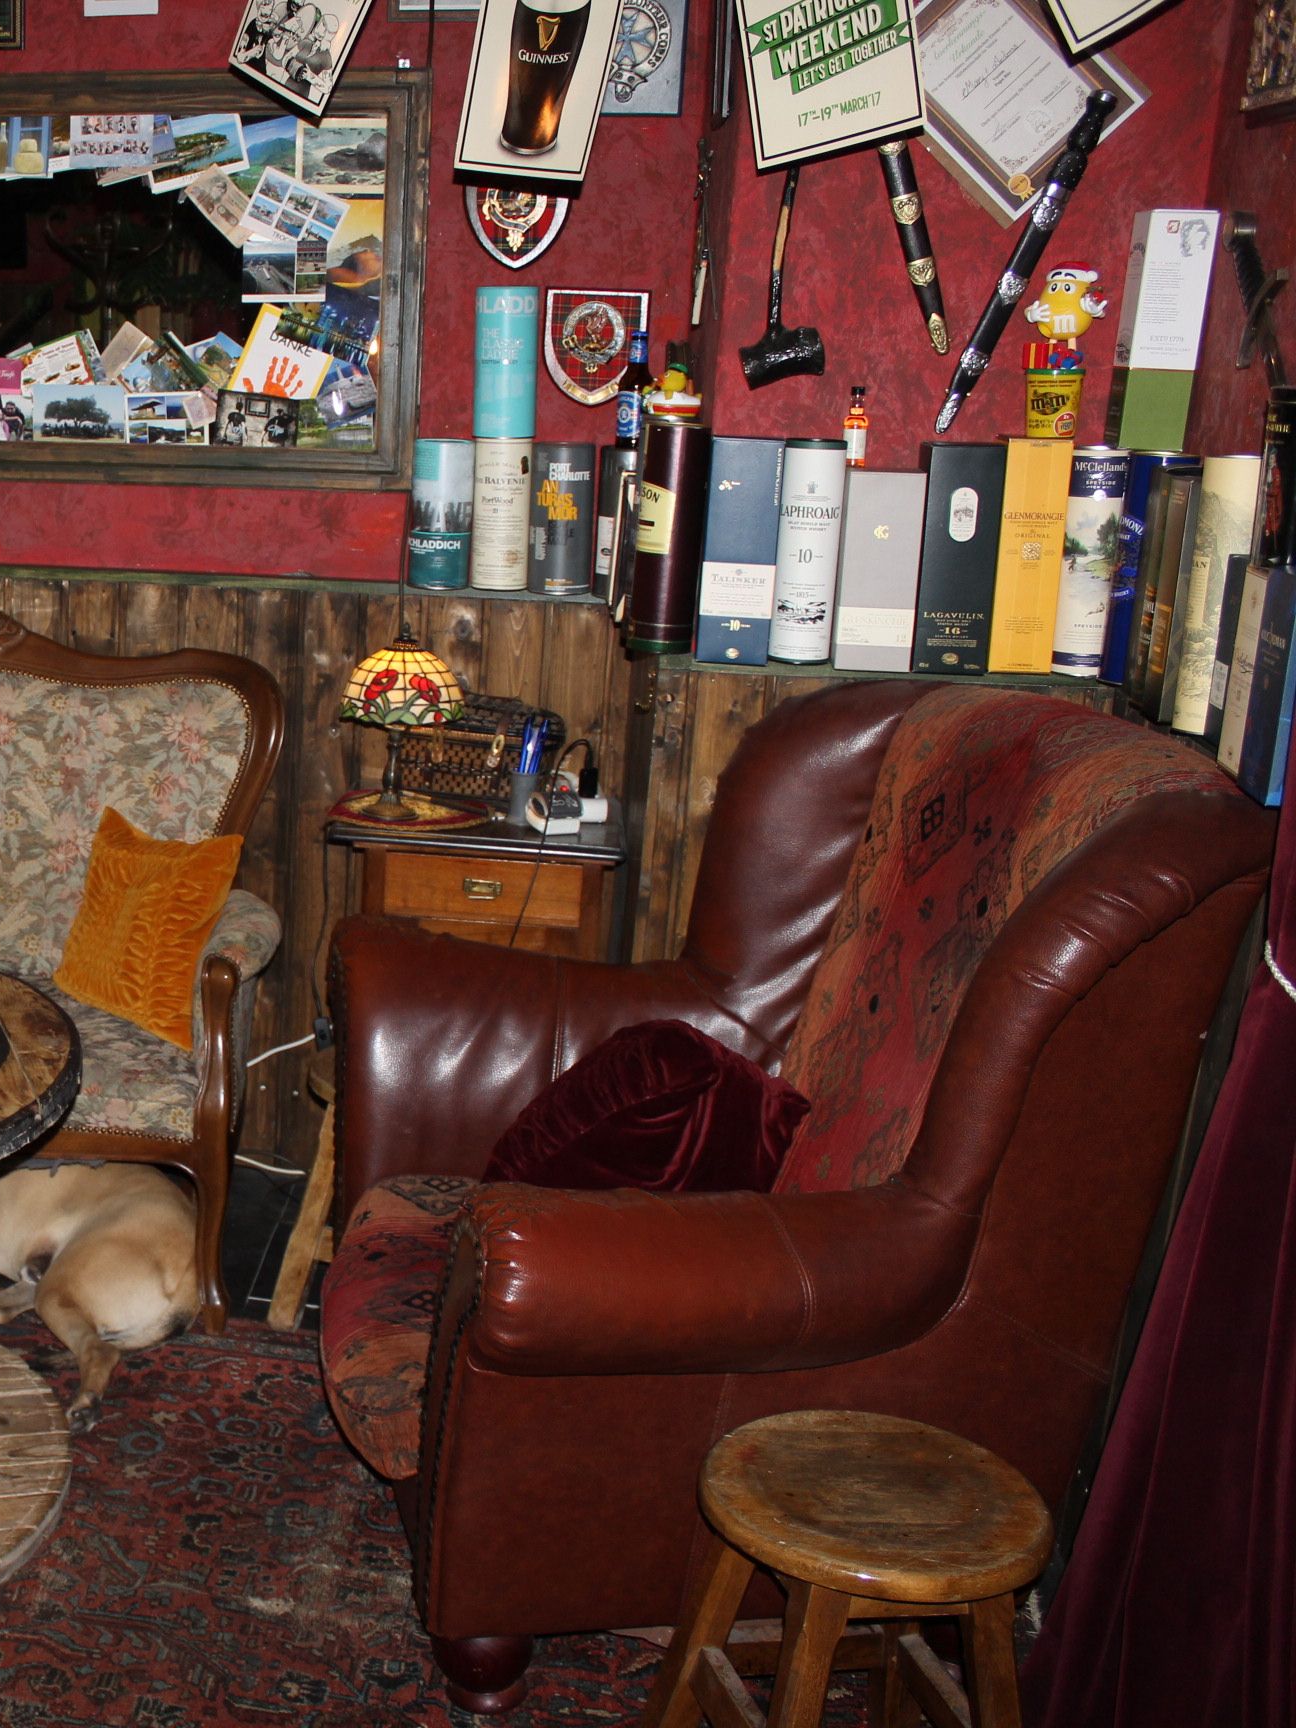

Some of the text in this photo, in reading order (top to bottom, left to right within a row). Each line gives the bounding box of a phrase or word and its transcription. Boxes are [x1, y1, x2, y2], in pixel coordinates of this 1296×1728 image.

[762, 19, 779, 43] ST
[776, 3, 882, 75] WEEKEND
[518, 49, 572, 64] GUINNESS
[647, 33, 669, 68] CORPS
[797, 29, 898, 90] LET'S GET TOGETHER
[1053, 314, 1077, 333] m
[482, 328, 500, 338] THE
[268, 330, 313, 359] DANKE
[481, 350, 519, 360] LADDIE
[549, 462, 572, 472] PORT
[548, 471, 591, 482] CHARLOTTE
[541, 479, 560, 492] AN
[536, 491, 575, 507] TURAS
[780, 503, 841, 520] LAPHROAIG
[1004, 511, 1064, 522] GLENMORANGIE
[798, 548, 813, 564] 10
[711, 573, 767, 585] TALISKER
[923, 611, 985, 620] LAGAVULIN
[729, 619, 741, 632] 10
[944, 626, 962, 635] 16
